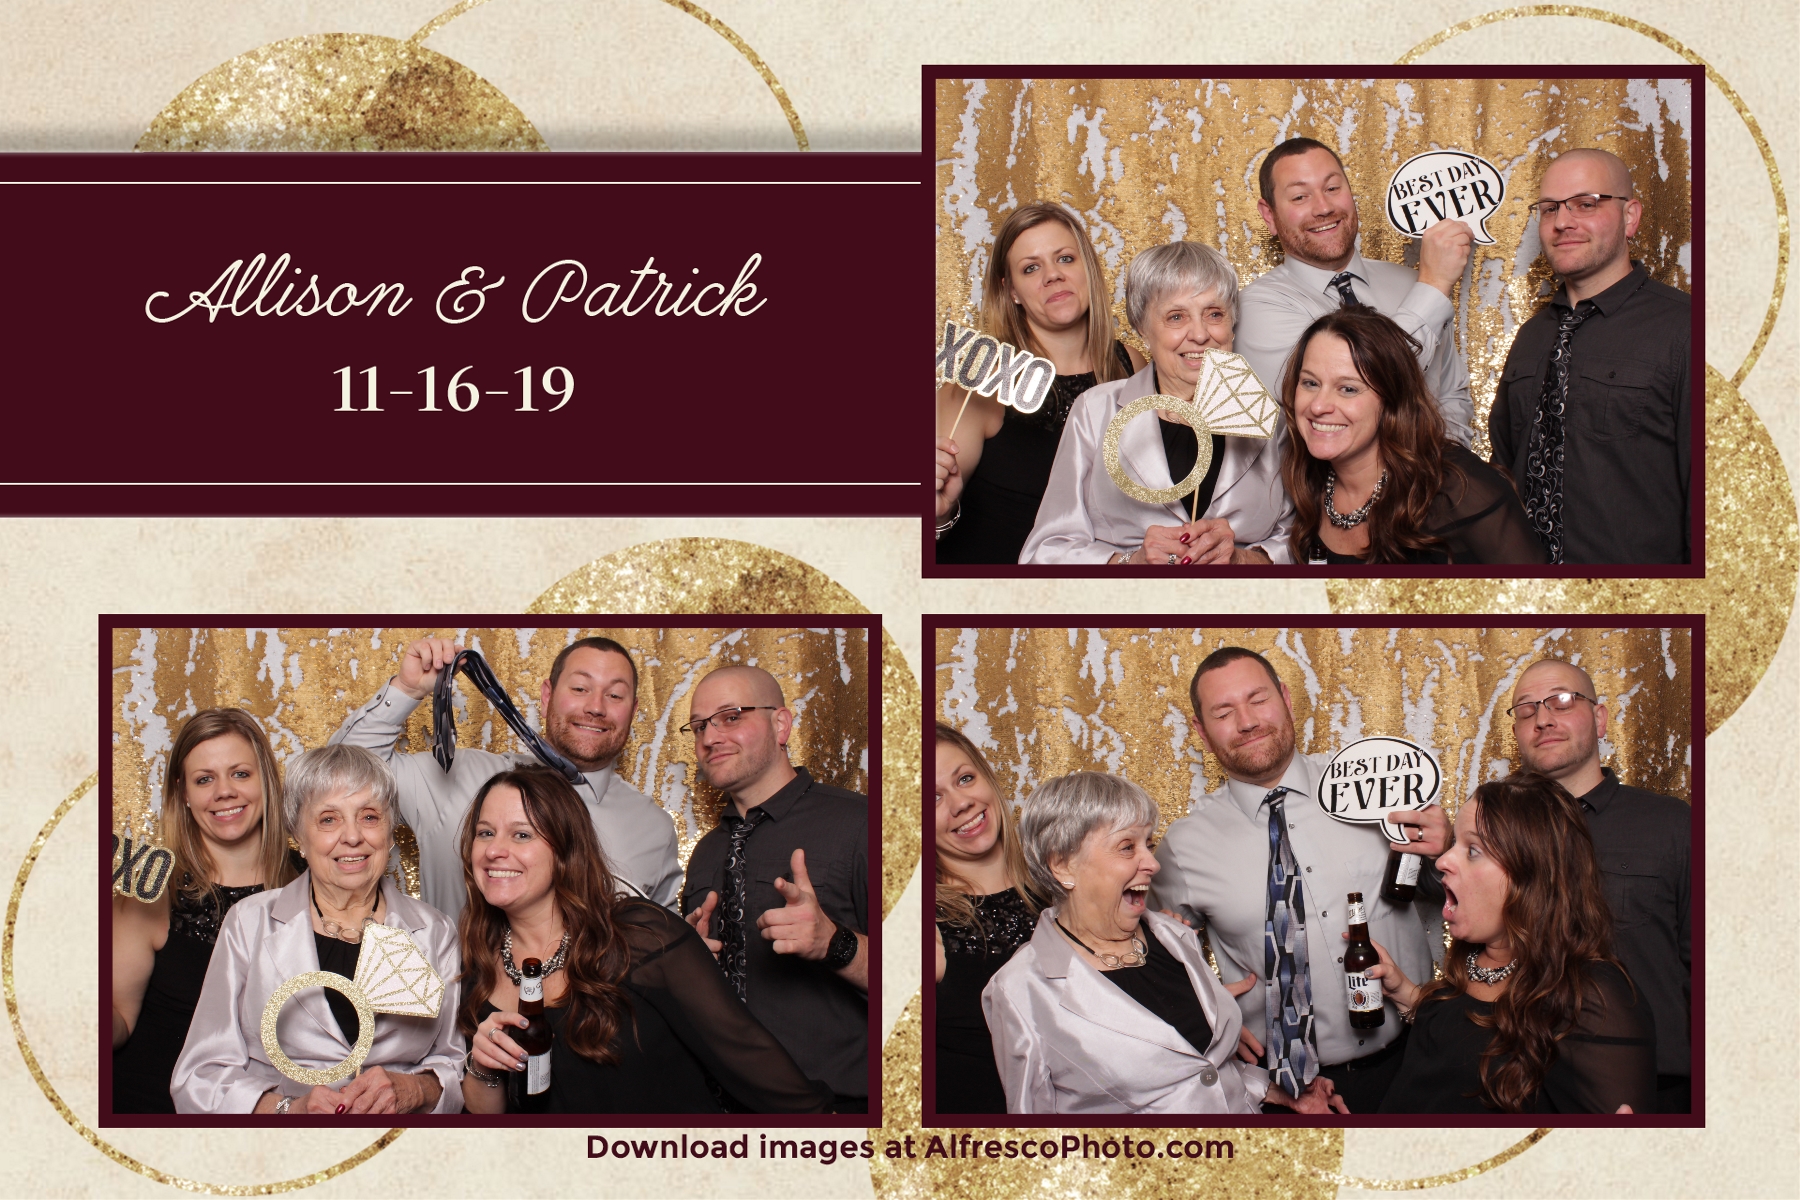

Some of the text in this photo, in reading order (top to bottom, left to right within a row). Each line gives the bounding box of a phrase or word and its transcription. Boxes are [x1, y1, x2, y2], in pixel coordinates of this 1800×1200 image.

[1392, 157, 1482, 201] BEST DAY
[1399, 179, 1500, 234] EVER
[936, 321, 1055, 412] XOXO
[1330, 749, 1425, 779] BEST DAY
[1329, 773, 1428, 814] EVER
[1347, 975, 1369, 991] Lite
